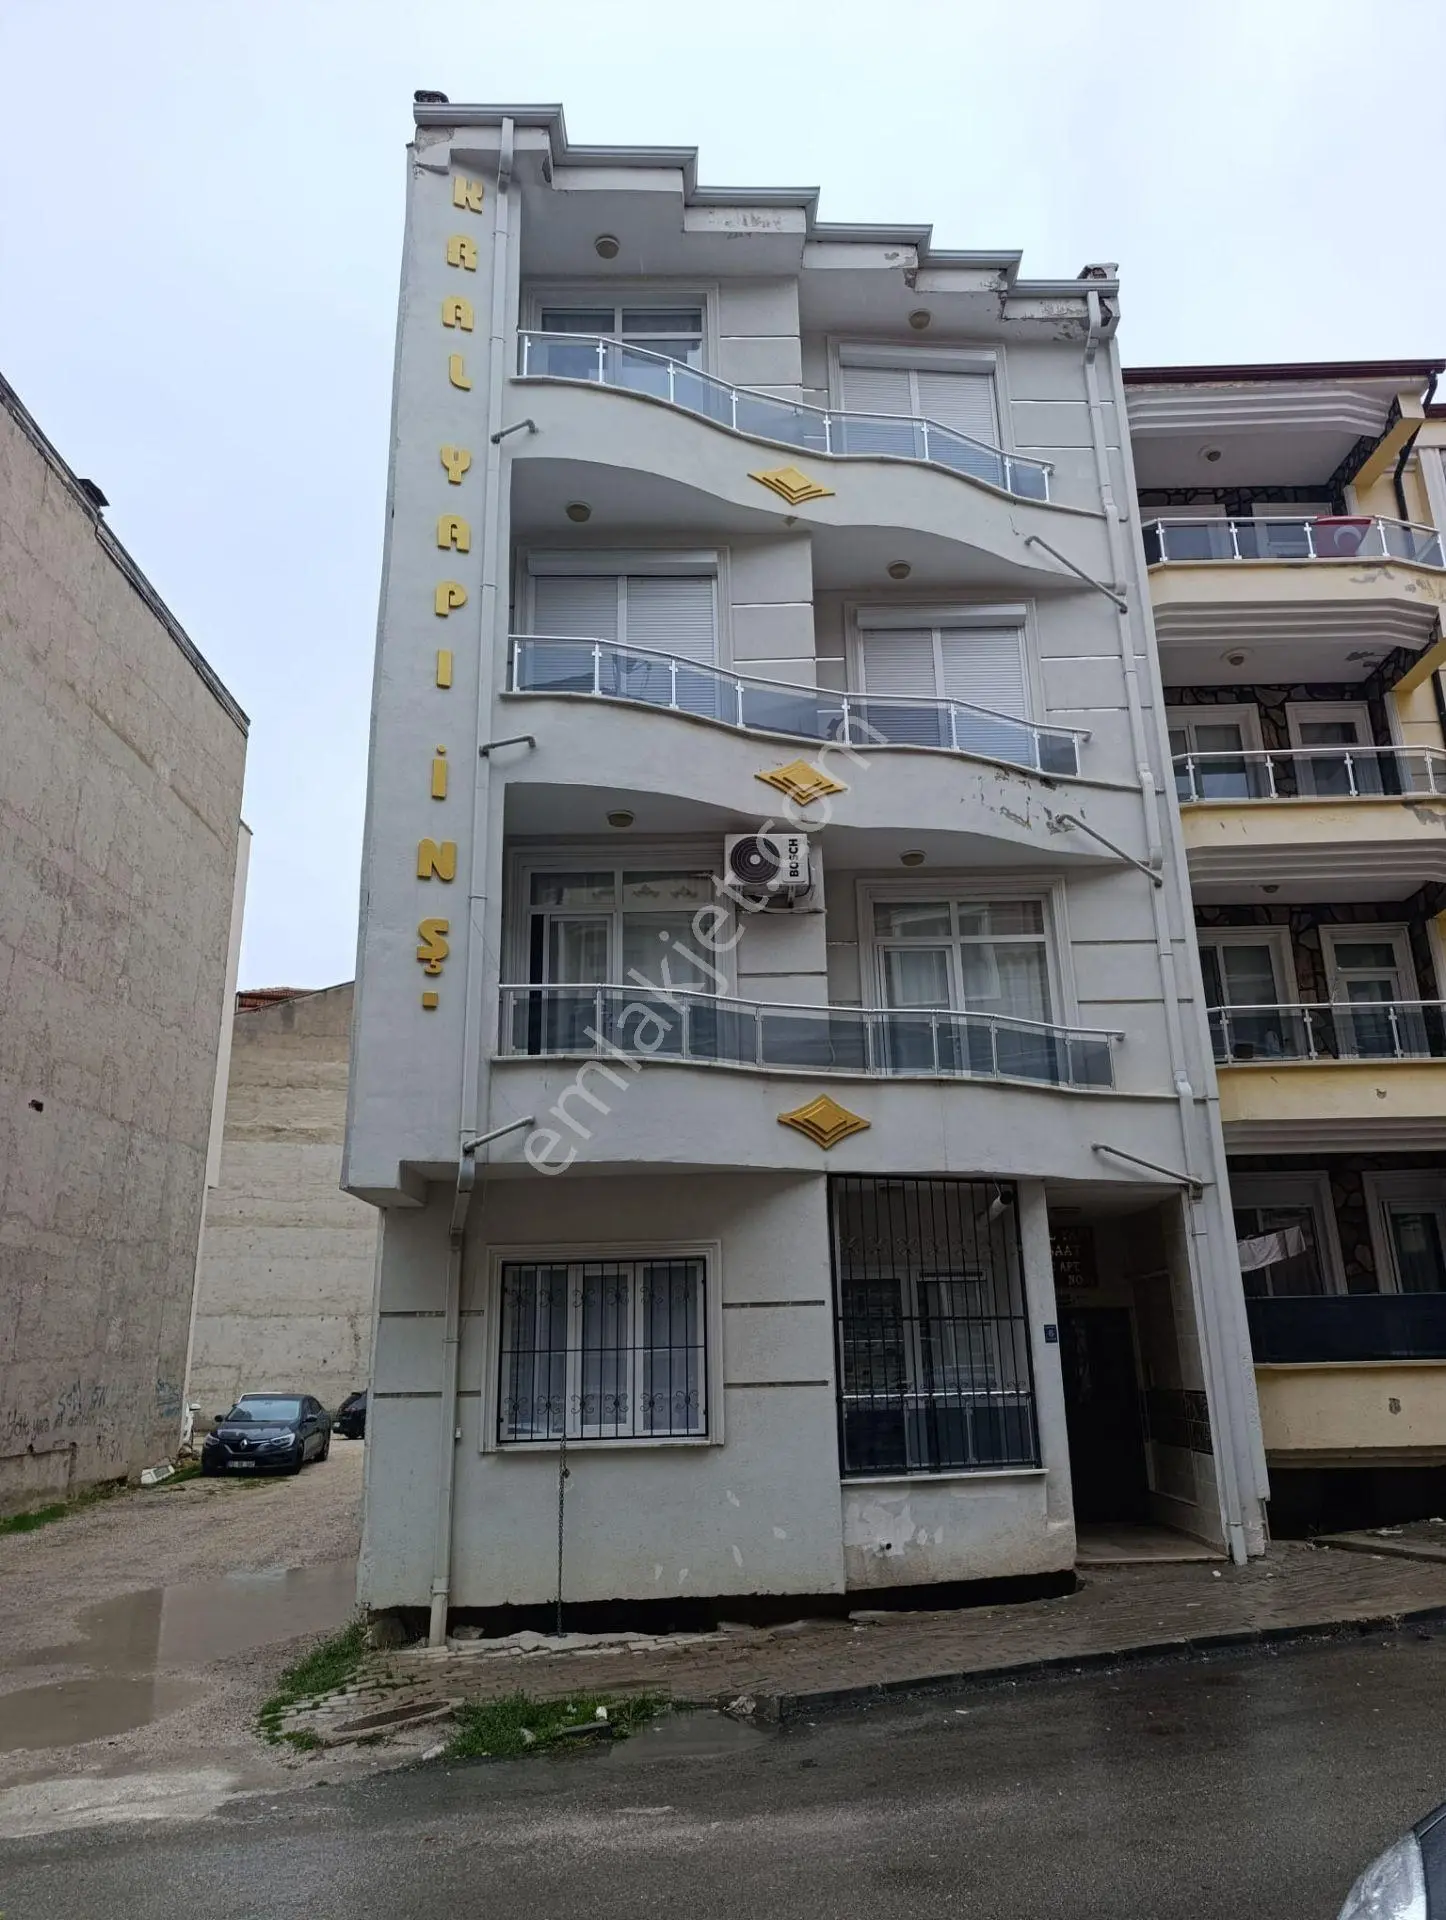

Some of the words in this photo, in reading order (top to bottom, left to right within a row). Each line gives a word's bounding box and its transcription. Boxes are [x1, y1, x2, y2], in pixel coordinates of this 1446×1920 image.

[442, 175, 484, 392] KRAL
[434, 444, 472, 690] YAPI
[788, 838, 799, 877] BOSCH
